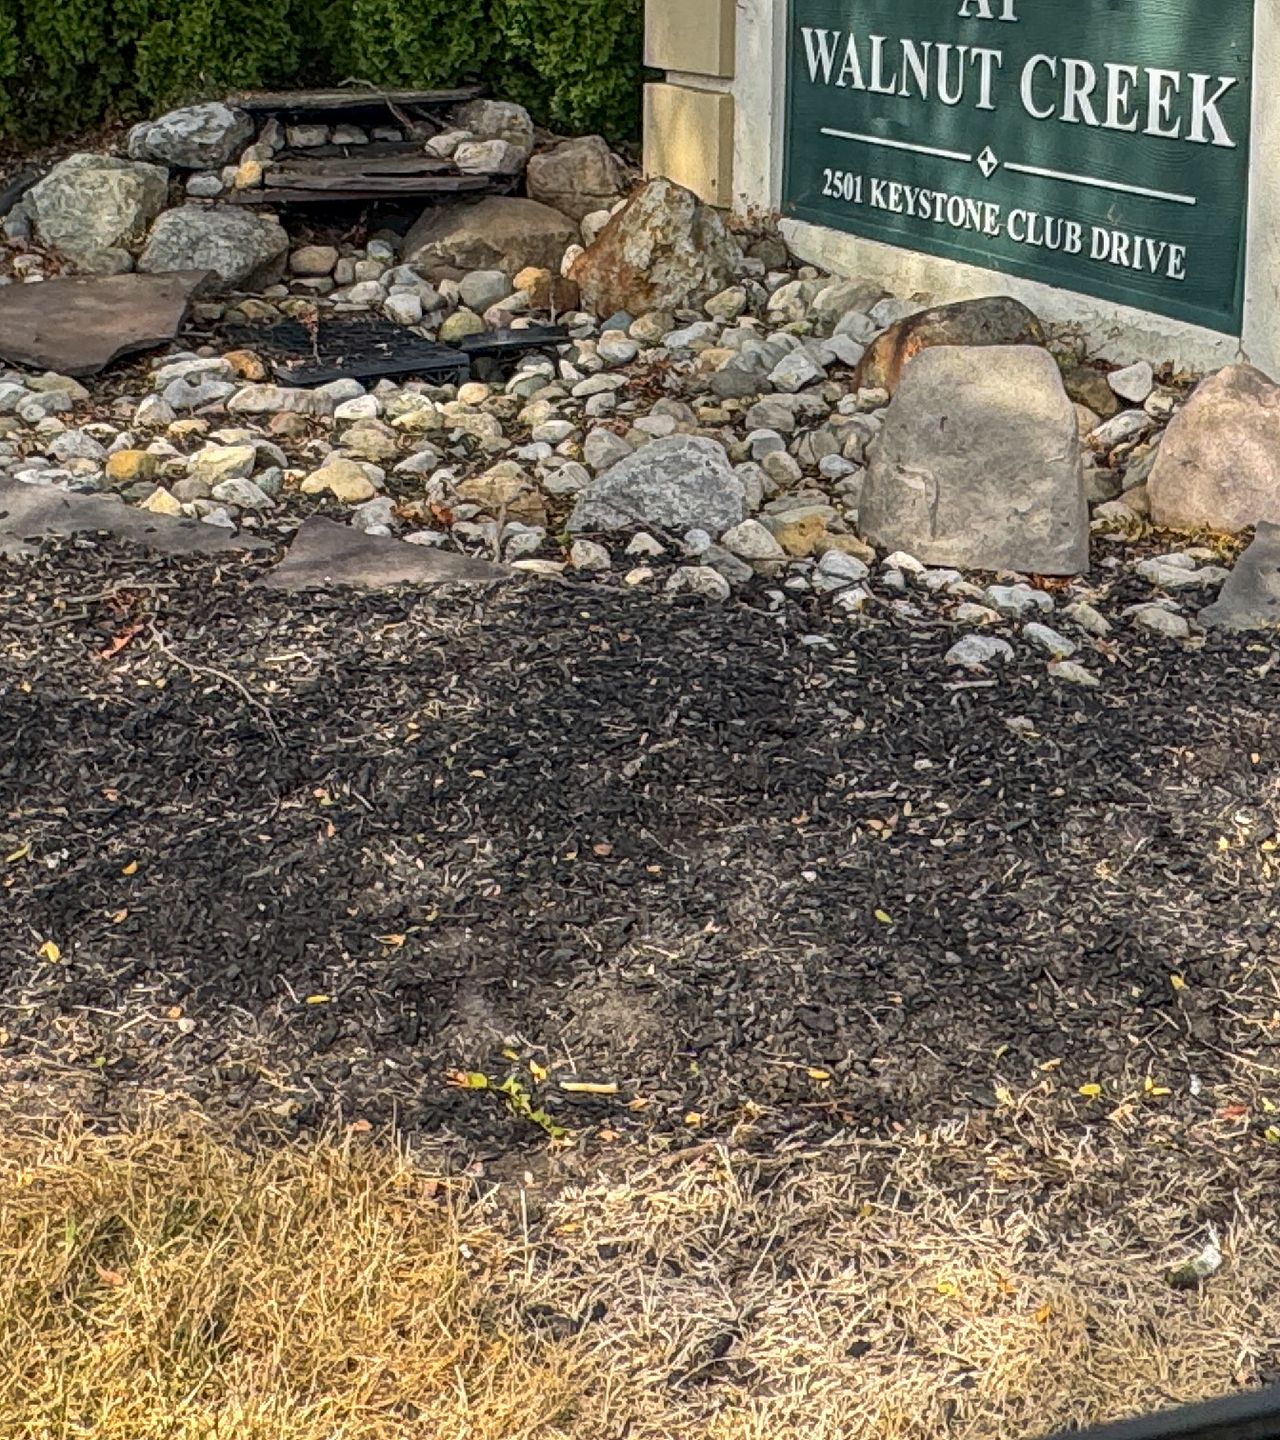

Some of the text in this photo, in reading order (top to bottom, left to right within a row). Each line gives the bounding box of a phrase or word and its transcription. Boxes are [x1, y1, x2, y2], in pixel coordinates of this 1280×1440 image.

[800, 26, 1237, 146] WALNUT CREEK
[822, 168, 1185, 279] 2501 KEYSTONE CLUB DRIVE
